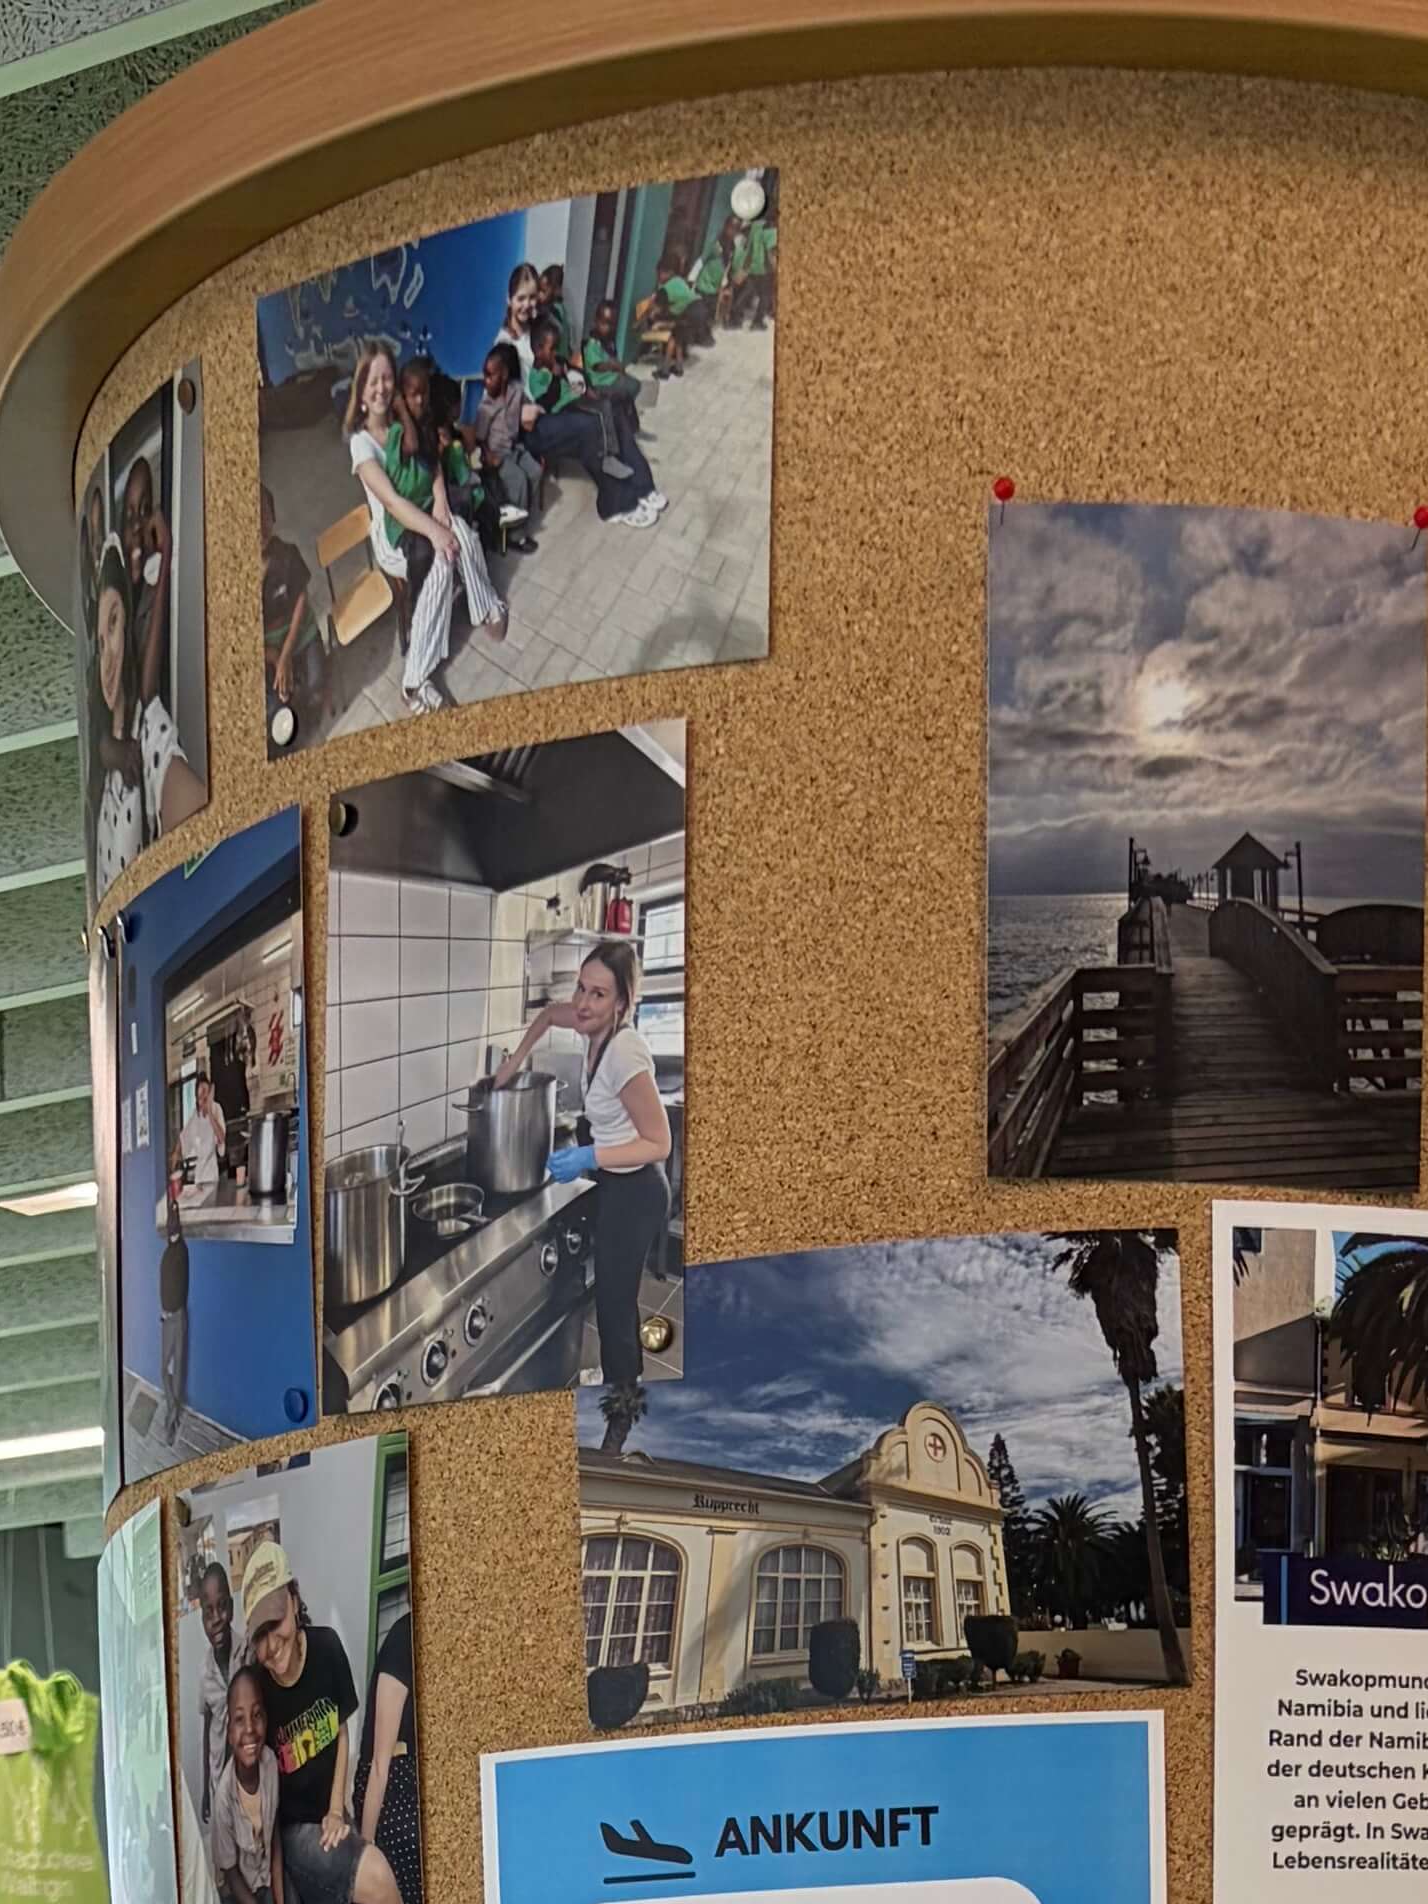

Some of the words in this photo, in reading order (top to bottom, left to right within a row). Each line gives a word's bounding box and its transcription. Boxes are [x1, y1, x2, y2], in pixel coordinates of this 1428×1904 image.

[1278, 1698, 1364, 1718] Namibia
[1370, 1701, 1409, 1720] und
[1268, 1728, 1323, 1748] Rand
[1328, 1729, 1363, 1748] der
[1266, 1759, 1303, 1778] der
[1307, 1759, 1416, 1780] deutschen
[1293, 1794, 1320, 1809] an
[1325, 1789, 1387, 1810] vielen
[713, 1805, 939, 1858] ANKUNFT
[1271, 1820, 1361, 1844] geprägt.
[1366, 1822, 1385, 1840] In
